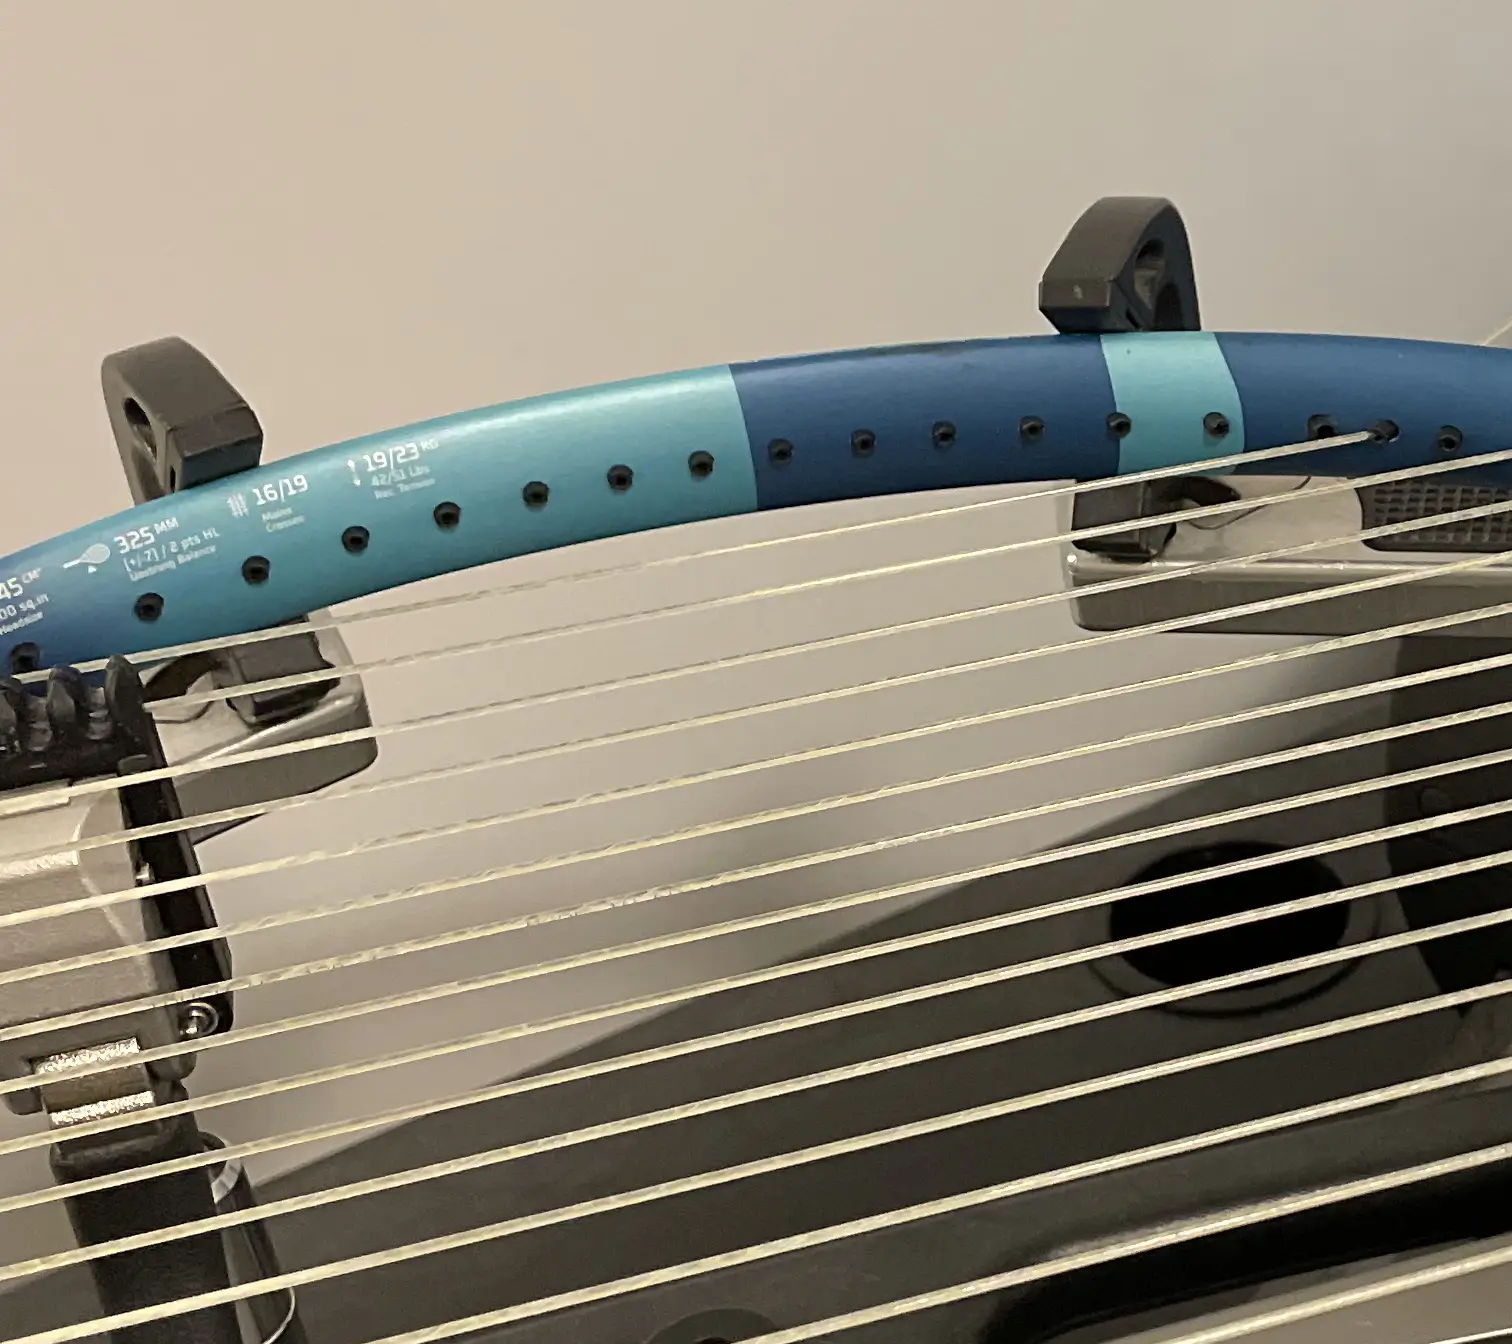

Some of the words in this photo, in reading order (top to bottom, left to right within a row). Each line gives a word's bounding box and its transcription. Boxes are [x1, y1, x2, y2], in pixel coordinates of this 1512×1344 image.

[362, 442, 420, 472] 19/23
[252, 474, 309, 506] 16/19
[114, 525, 155, 554] 325
[154, 517, 179, 535] MM
